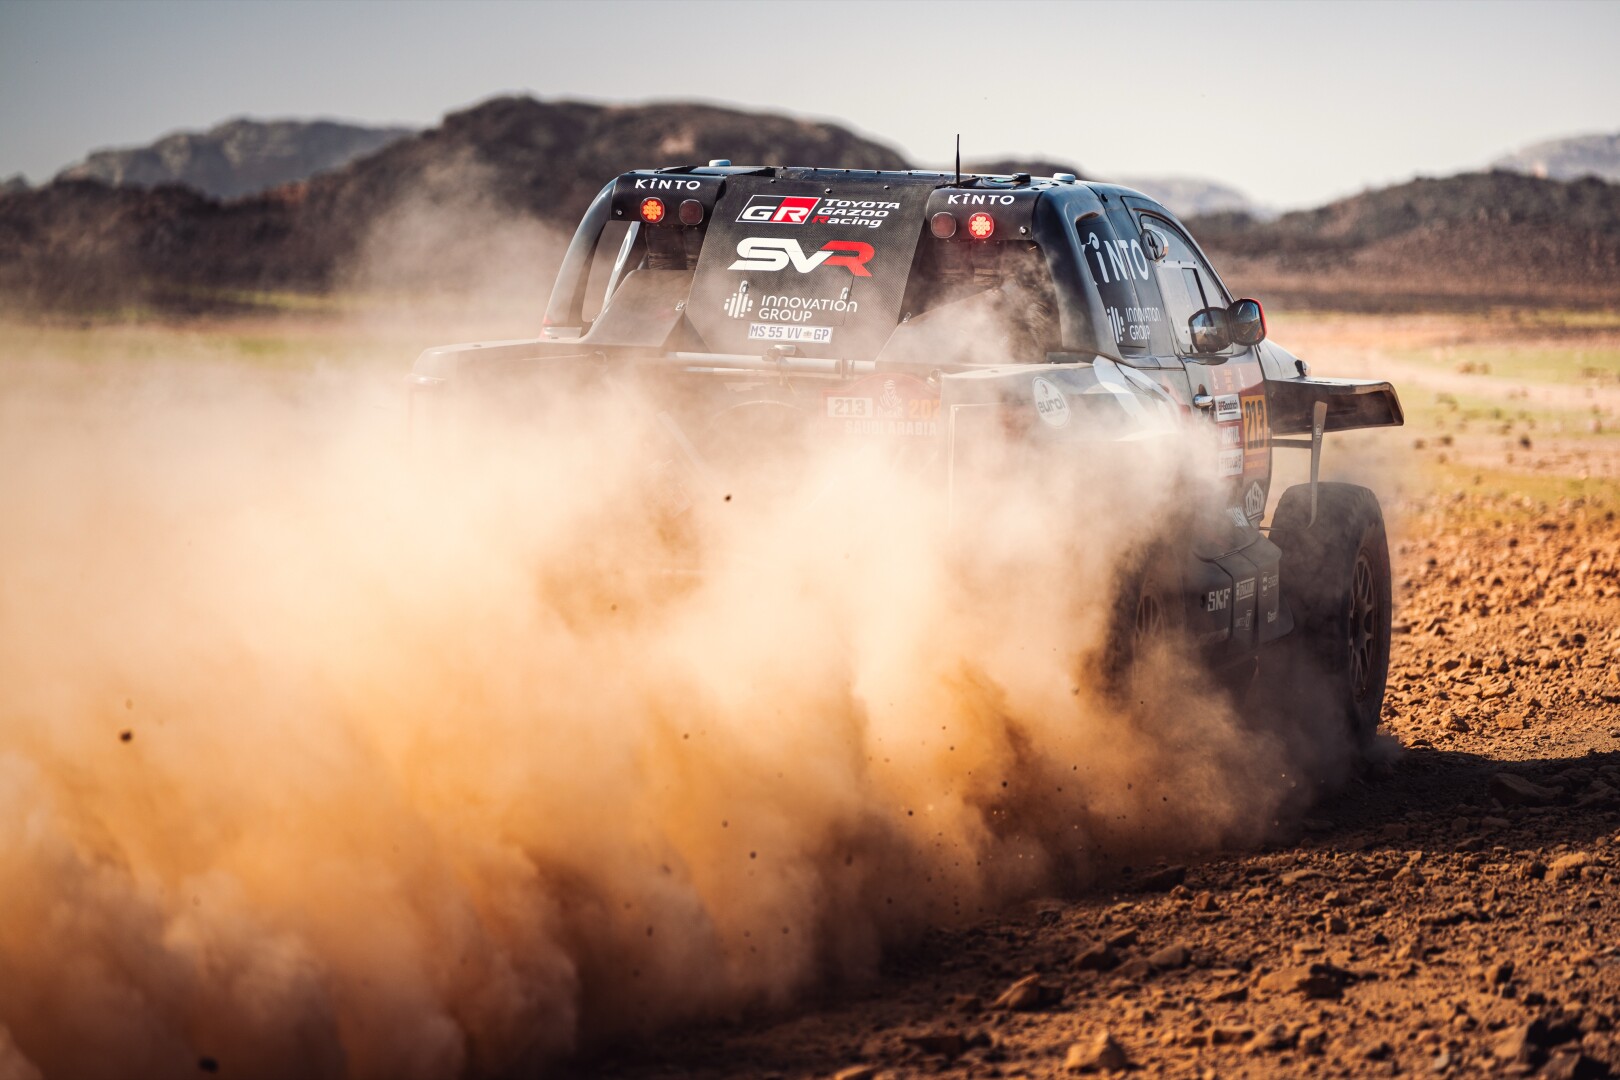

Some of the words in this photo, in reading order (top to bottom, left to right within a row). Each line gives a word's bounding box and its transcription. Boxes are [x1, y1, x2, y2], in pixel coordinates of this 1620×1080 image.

[634, 177, 701, 191] KINTO
[824, 198, 900, 210] TOYOTA
[947, 193, 1015, 206] KINTO
[741, 205, 810, 222] GR
[818, 206, 890, 218] GAZOO
[811, 215, 883, 229] Racing
[727, 237, 875, 277] SVR
[761, 294, 858, 313] INNOVATION
[758, 308, 813, 322] GROUP
[750, 325, 766, 337] MS
[767, 326, 783, 338] 55
[785, 327, 803, 340] VV
[813, 328, 830, 341] GP
[1129, 324, 1151, 341] GROUP
[834, 398, 866, 416] 213
[1037, 392, 1066, 414] eurol
[846, 421, 886, 434] SAUDI
[888, 422, 937, 436] ARABIA
[1244, 399, 1265, 450] 213
[1207, 587, 1232, 612] SKF
